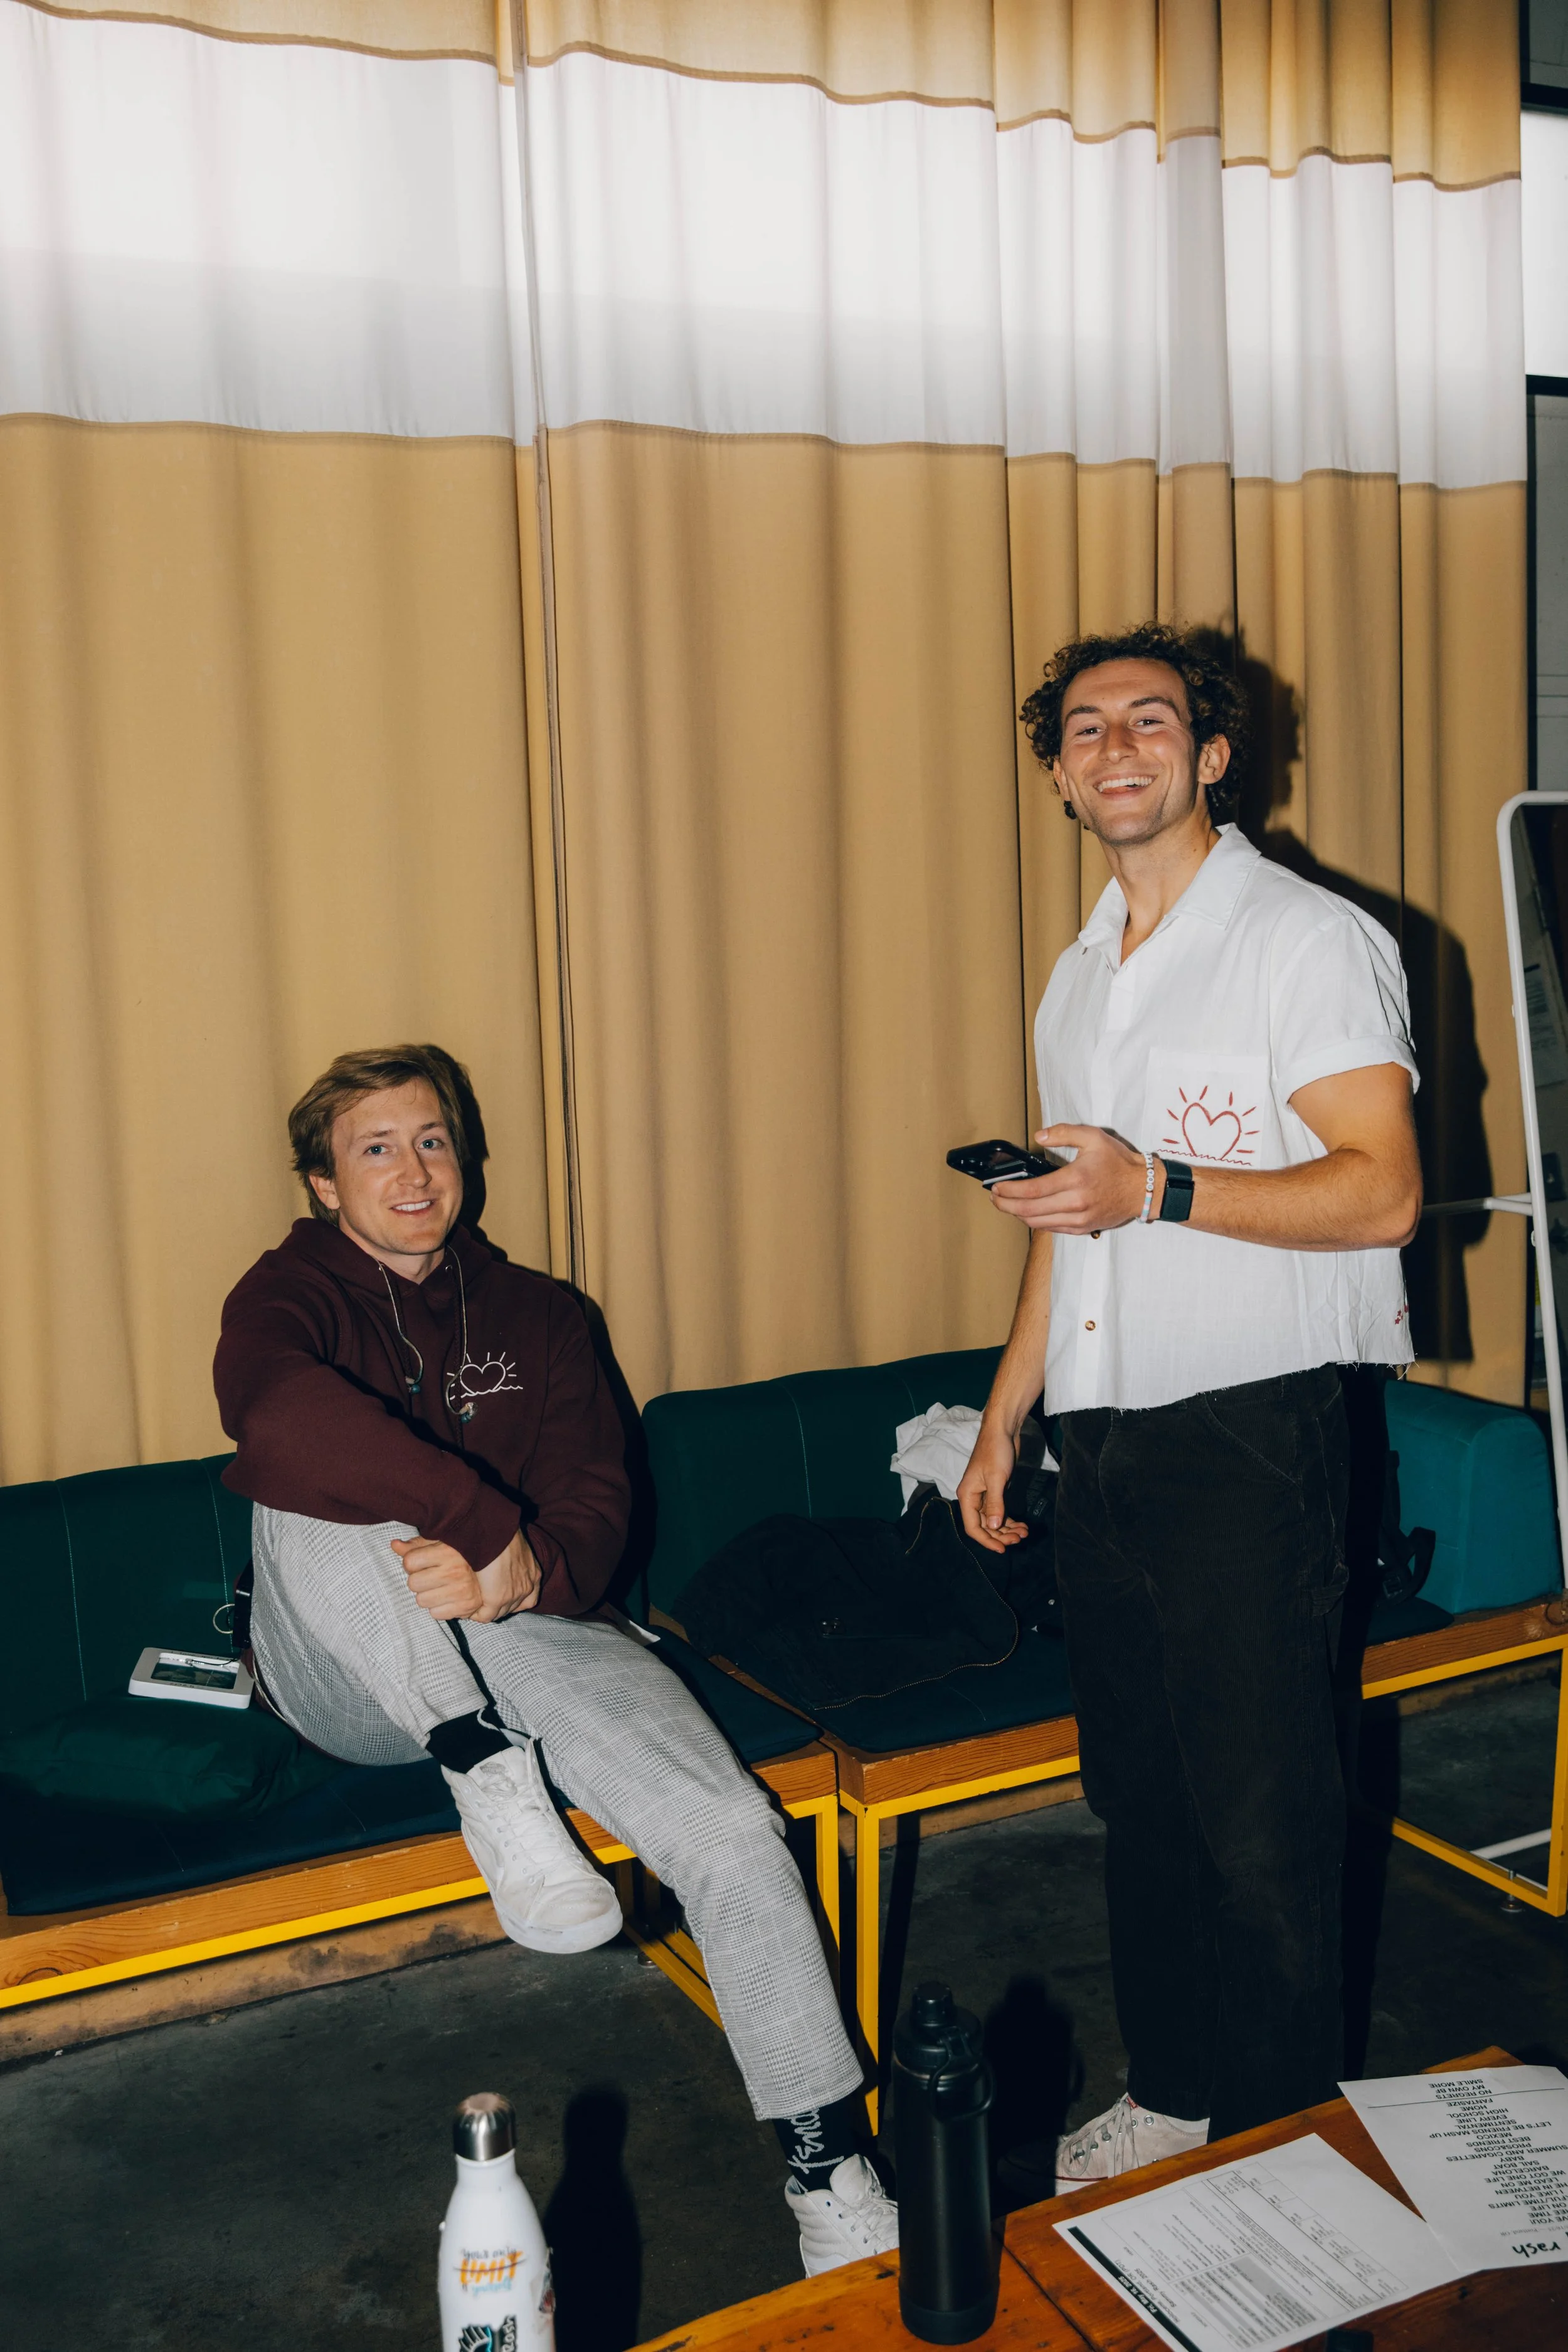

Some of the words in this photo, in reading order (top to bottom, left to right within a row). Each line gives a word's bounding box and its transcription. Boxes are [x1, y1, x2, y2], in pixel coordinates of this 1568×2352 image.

[1435, 2091, 1476, 2099] REGRETS
[1446, 2098, 1493, 2107] FANTASIZE
[1446, 2111, 1484, 2119] SCHOOL
[1454, 2119, 1517, 2130] SENTIMENTAL
[1466, 2139, 1505, 2147] FRIENDS
[1474, 2143, 1532, 2152] PROS&CONS
[1527, 2144, 1567, 2153] SUMMER
[1446, 2152, 1503, 2162] CIGARETTES
[1491, 2166, 1549, 2175] BARCELONA
[1495, 2186, 1540, 2195] BETWEEN
[1488, 2200, 1520, 2209] LIMITS
[1512, 2242, 1561, 2259] rash
[460, 2250, 524, 2284] LIMIT
[1114, 2259, 1130, 2273] (PDT)
[1133, 2268, 1148, 2280] 2025
[1118, 2275, 1131, 2288] 2025
[1146, 2279, 1159, 2291] Rash
[1136, 2281, 1156, 2300] Portland,
[1138, 2294, 1149, 2304] May
[1160, 2291, 1177, 2307] Sammy
[1149, 2304, 1158, 2312] Fri,
